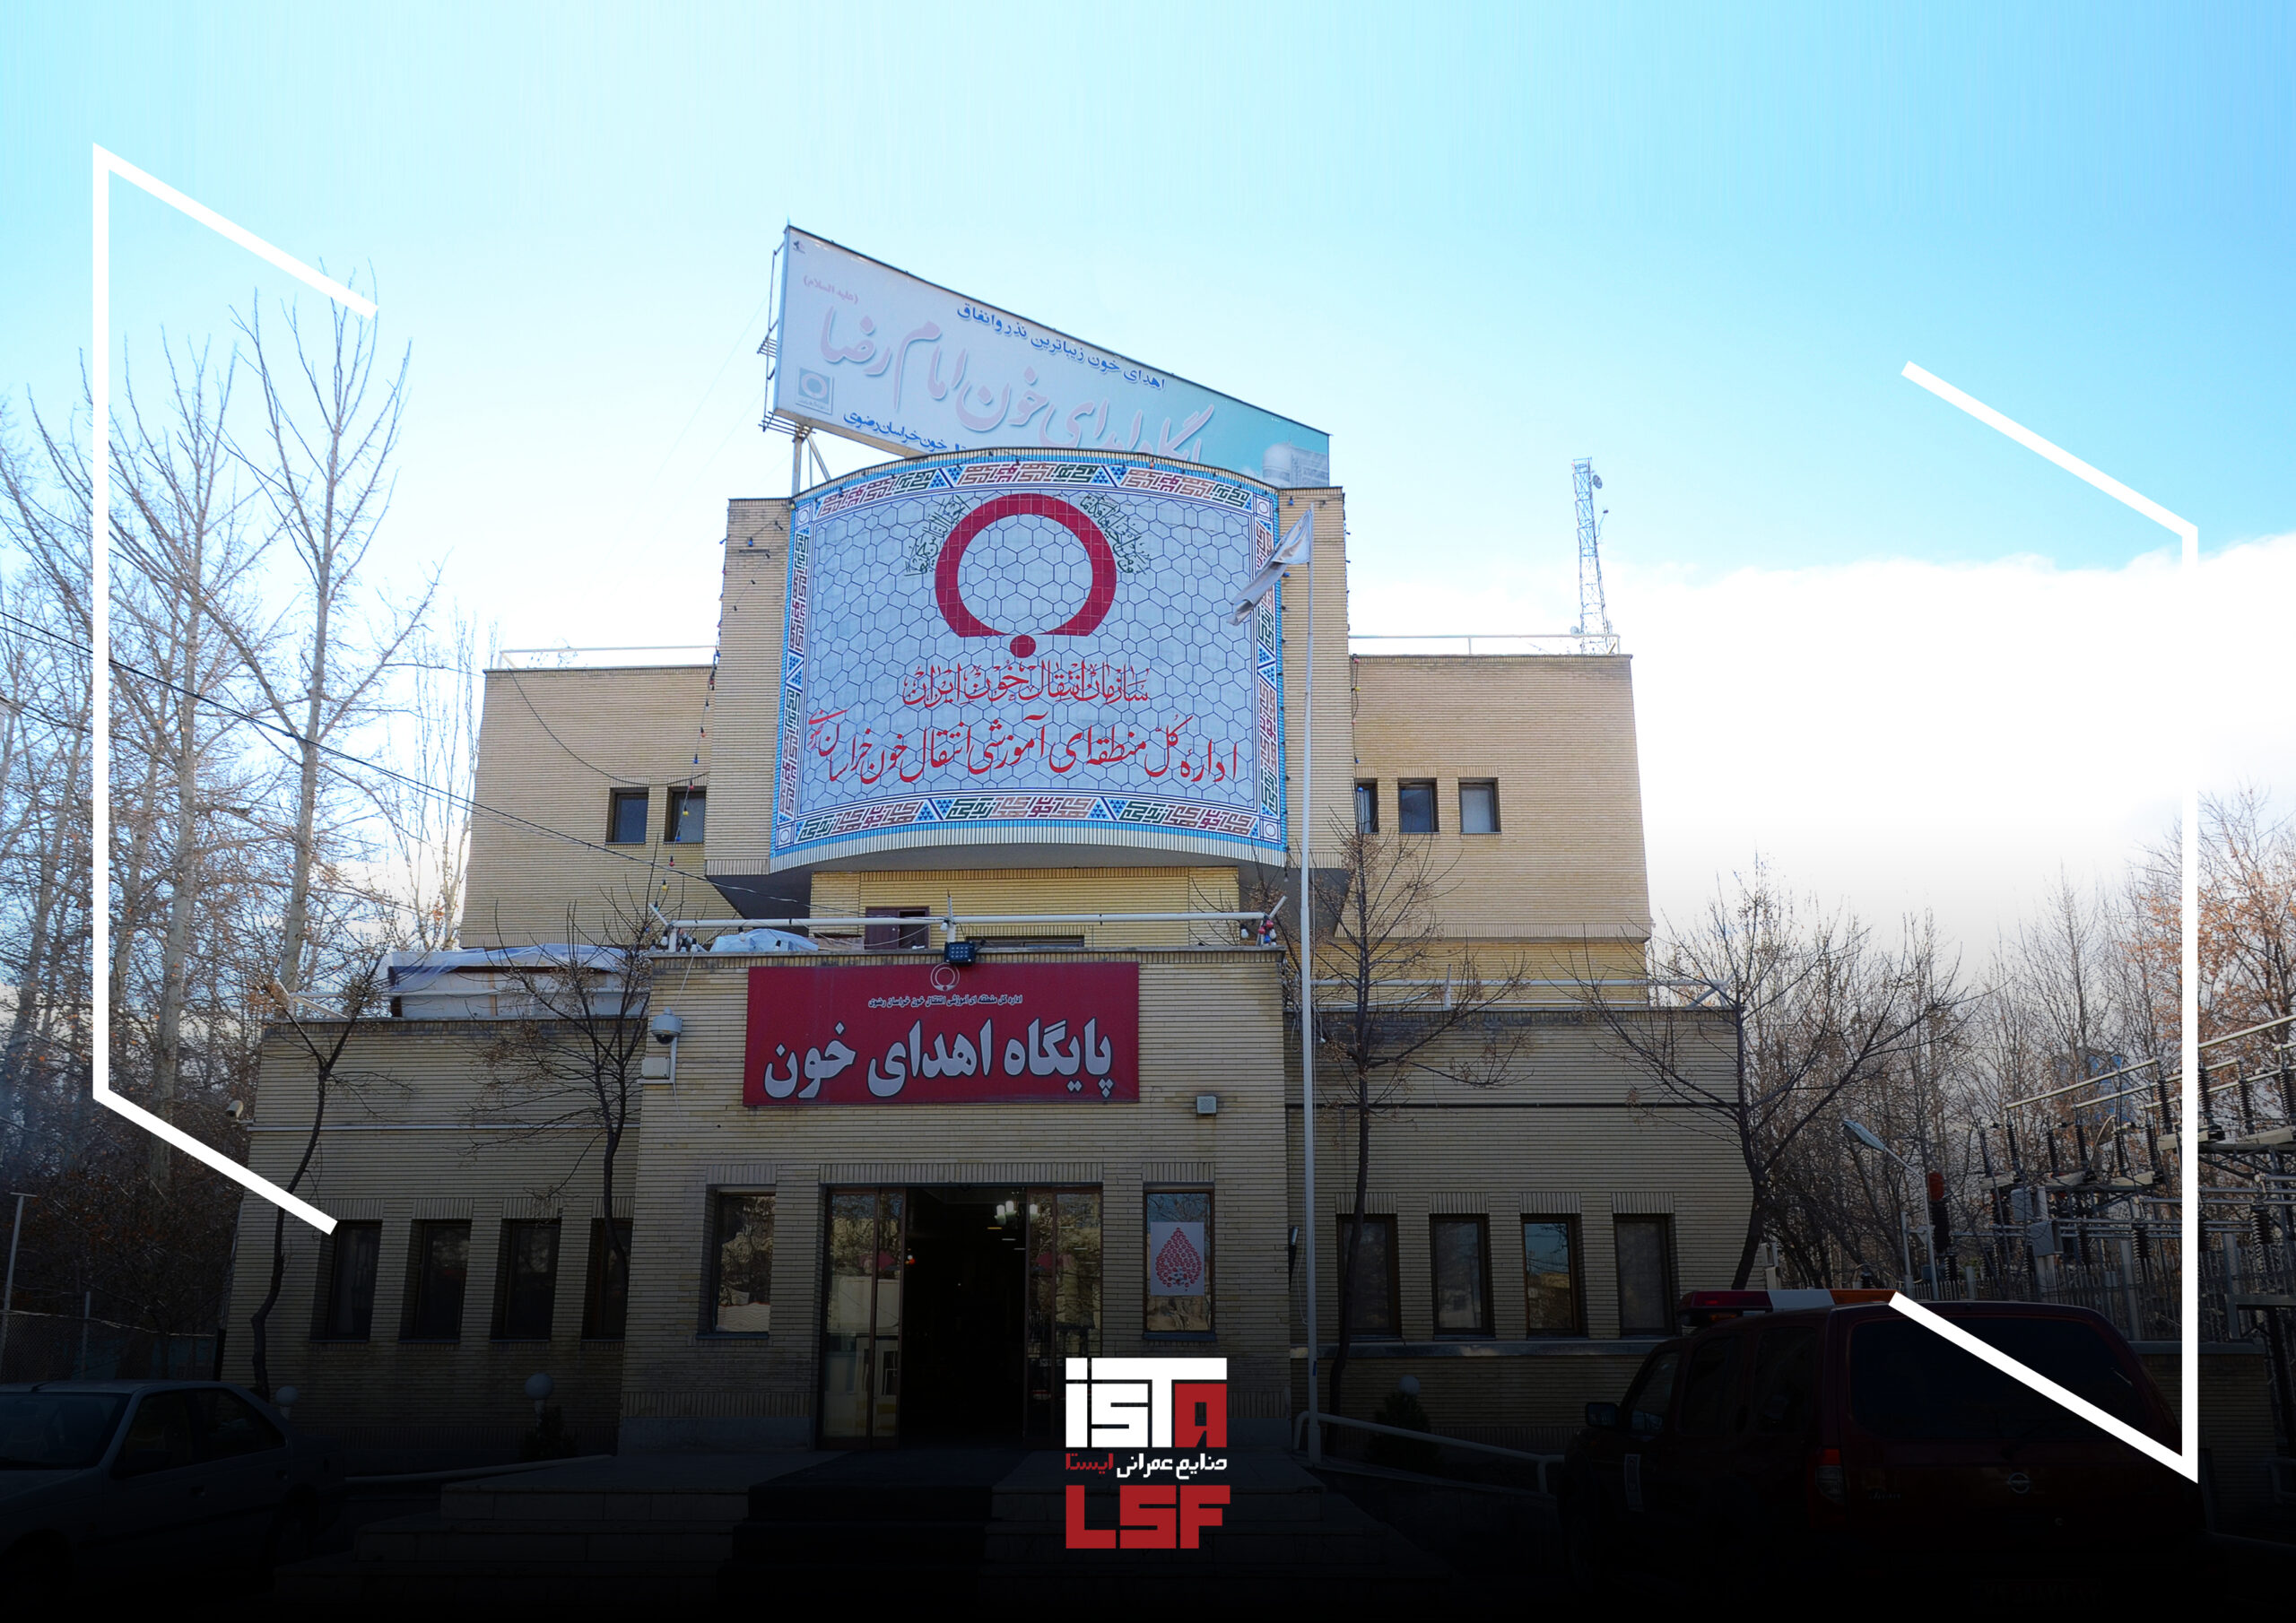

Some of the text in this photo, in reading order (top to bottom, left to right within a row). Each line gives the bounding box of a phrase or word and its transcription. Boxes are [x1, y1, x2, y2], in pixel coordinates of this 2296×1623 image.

[1004, 322, 1028, 338] نذر
[820, 306, 893, 378] رضا
[1031, 336, 1085, 363] زیباترین
[893, 320, 968, 412] امام
[1087, 357, 1120, 373] خون
[1123, 369, 1166, 390] اهدای
[955, 365, 1049, 433] خون
[843, 412, 880, 431] رضوی
[876, 421, 921, 443] خراسان
[919, 438, 947, 452] خون
[903, 660, 1150, 707] سازمان انتقال خون ایران
[818, 723, 873, 782] خراسان
[900, 721, 971, 783] انتقال
[968, 711, 1049, 775] آموزشی
[860, 733, 909, 784] خون
[868, 997, 886, 1008] رضوی
[887, 996, 910, 1008] خراسان
[911, 996, 925, 1007] خون
[926, 995, 946, 1007] انتقال
[946, 994, 969, 1006] آموزشی
[997, 994, 1008, 1005] کل
[1009, 994, 1023, 1005] اداره
[763, 1017, 1115, 1099] پایگاه اهدای خون
